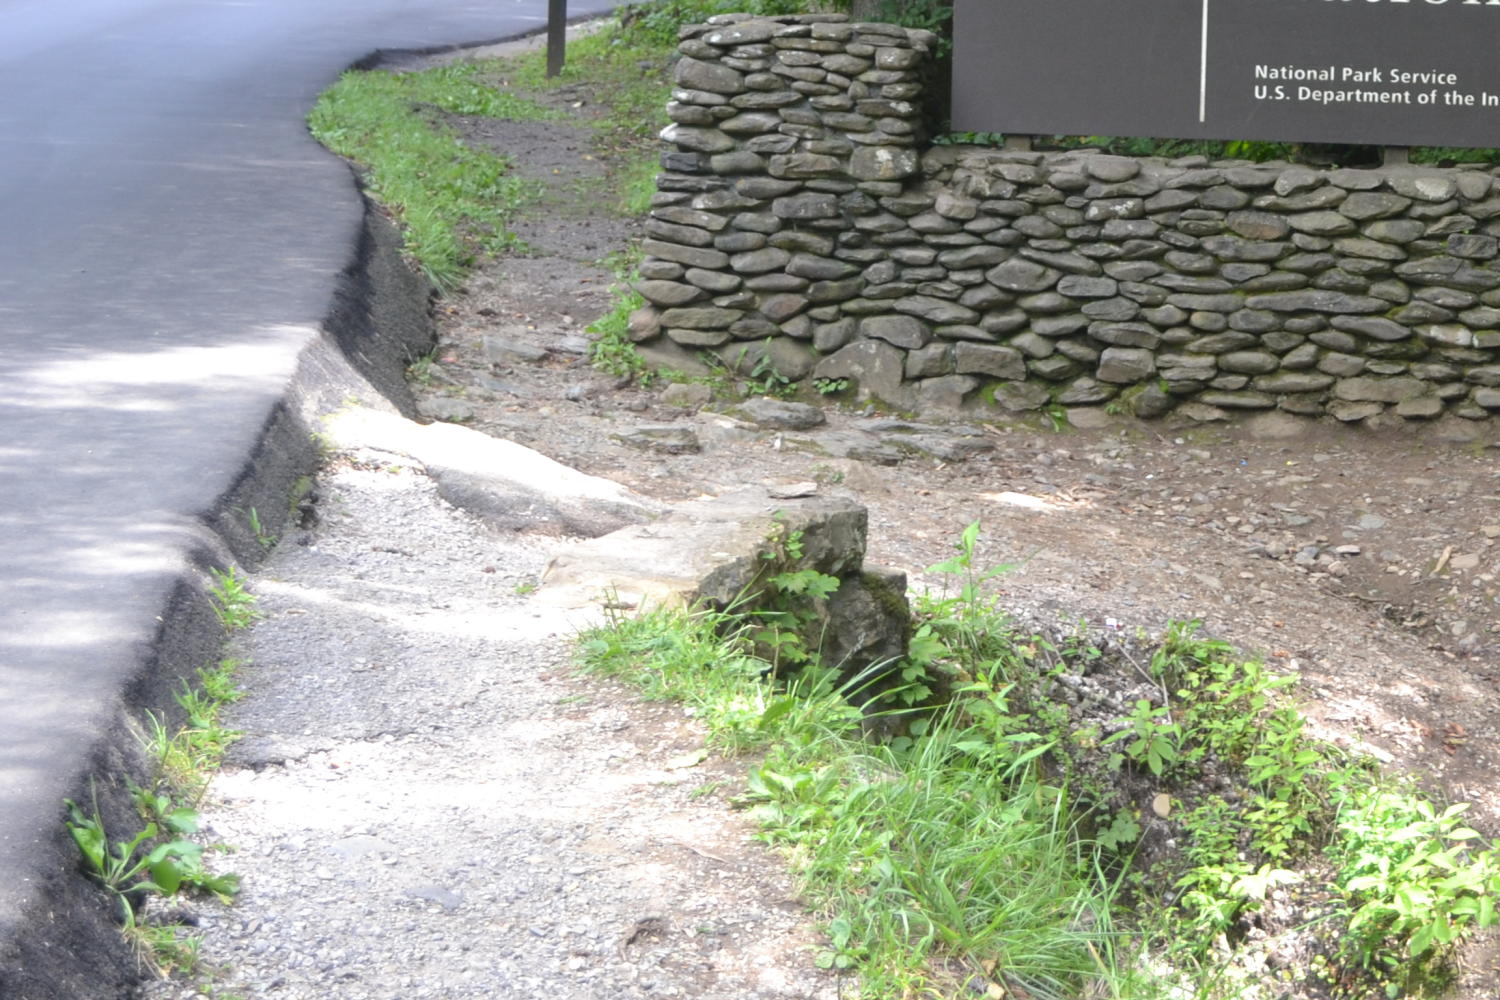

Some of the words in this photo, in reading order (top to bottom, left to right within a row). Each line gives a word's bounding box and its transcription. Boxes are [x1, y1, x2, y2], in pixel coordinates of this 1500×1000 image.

[1254, 64, 1335, 81] National
[1342, 67, 1383, 83] Park
[1390, 68, 1457, 85] Service
[1254, 85, 1290, 100] U.S.
[1297, 86, 1411, 105] Department
[1417, 89, 1438, 105] of
[1443, 90, 1475, 106] the
